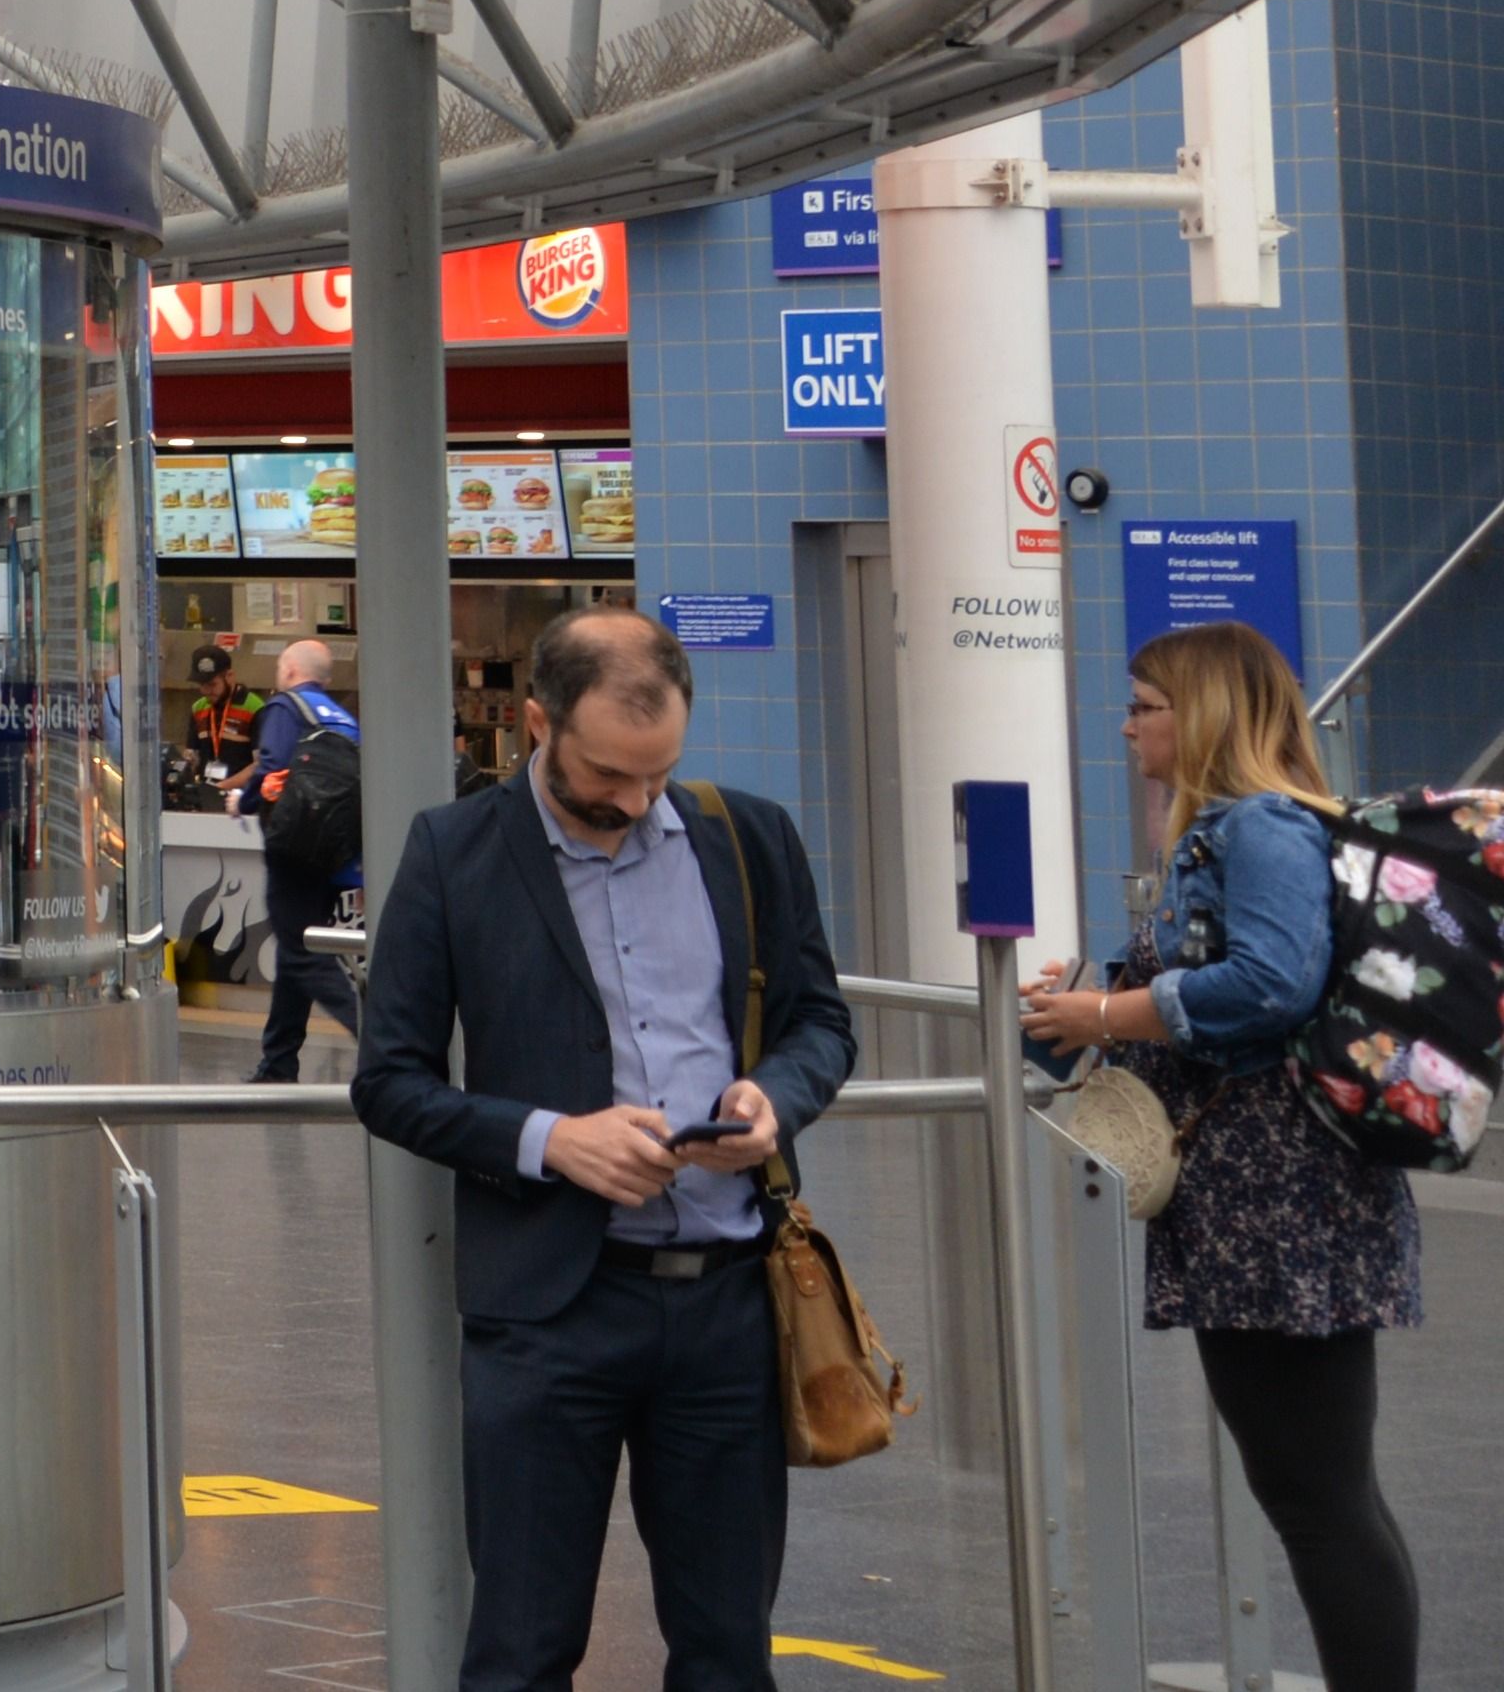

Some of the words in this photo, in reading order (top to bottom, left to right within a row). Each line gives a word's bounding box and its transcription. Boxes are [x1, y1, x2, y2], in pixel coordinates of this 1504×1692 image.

[525, 233, 592, 277] BURGER
[529, 253, 596, 301] KING
[802, 332, 878, 366] LIFT
[791, 374, 887, 408] ONLY
[1167, 530, 1236, 545] Accessible
[1238, 530, 1259, 545] lift
[952, 596, 1040, 618] FOLLOW
[1045, 598, 1061, 618] US
[23, 694, 63, 730] sold
